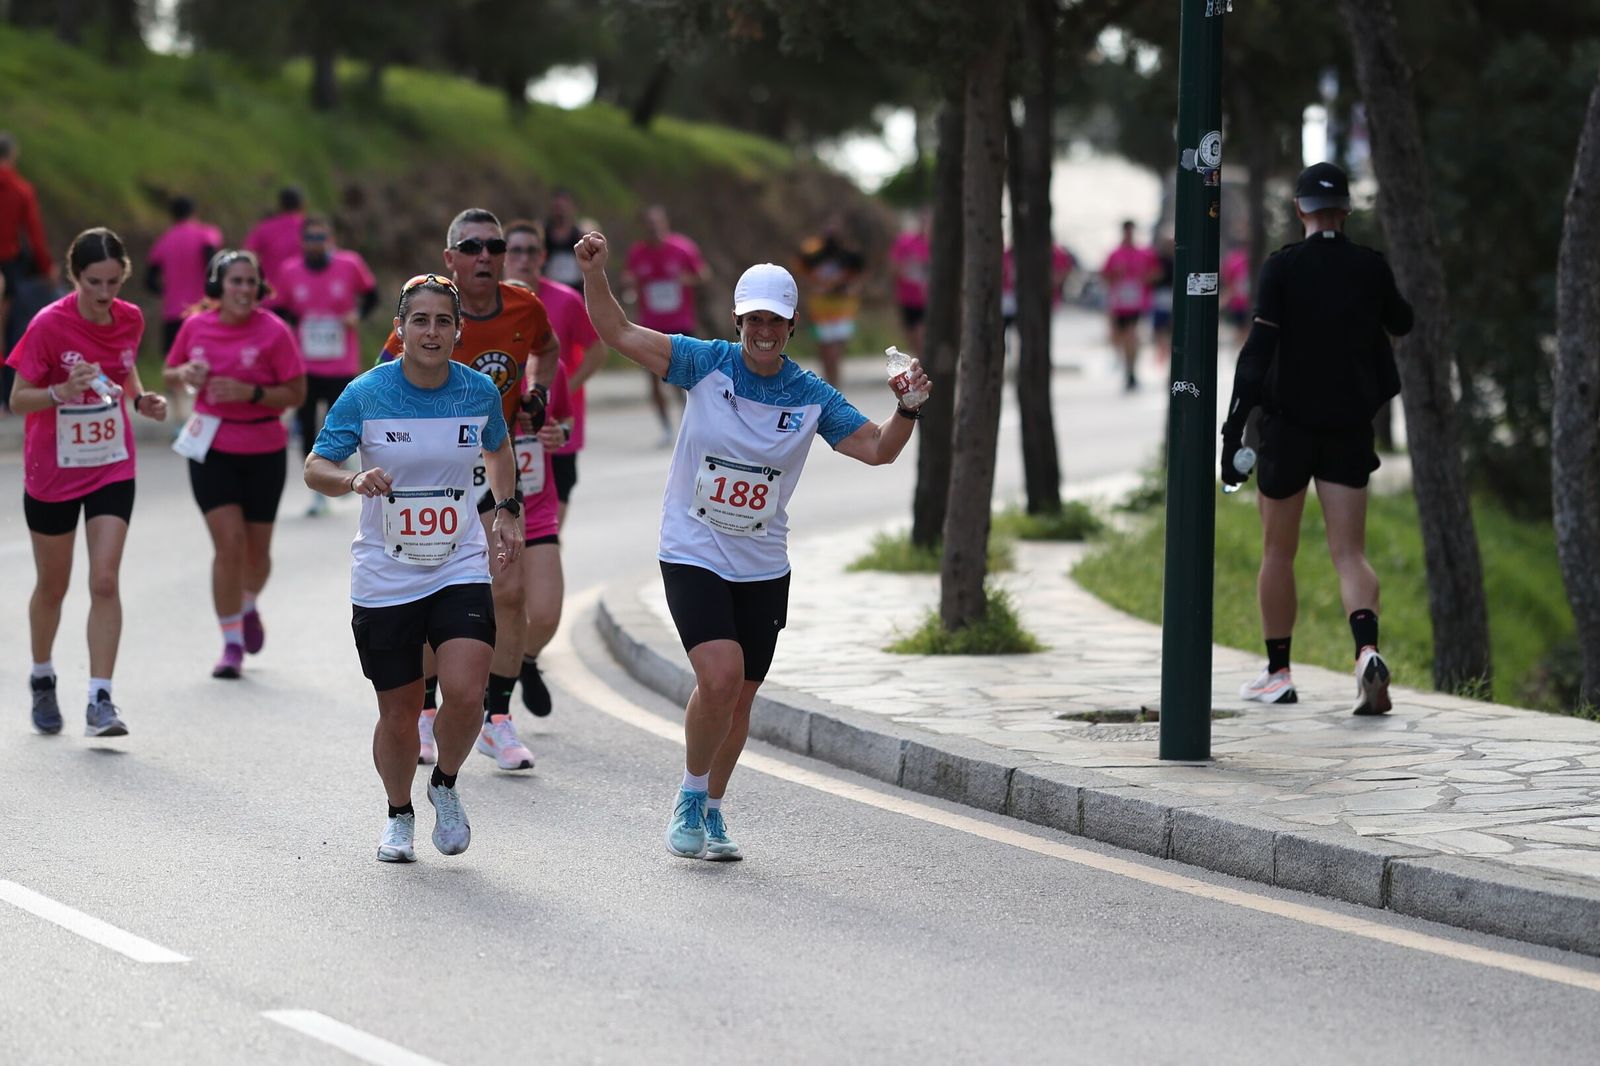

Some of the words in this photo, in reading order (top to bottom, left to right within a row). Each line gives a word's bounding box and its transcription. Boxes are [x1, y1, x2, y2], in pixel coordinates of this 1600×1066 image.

[476, 353, 508, 367] BEER
[72, 418, 116, 444] 138
[709, 476, 769, 511] 188
[399, 506, 458, 536] 190
